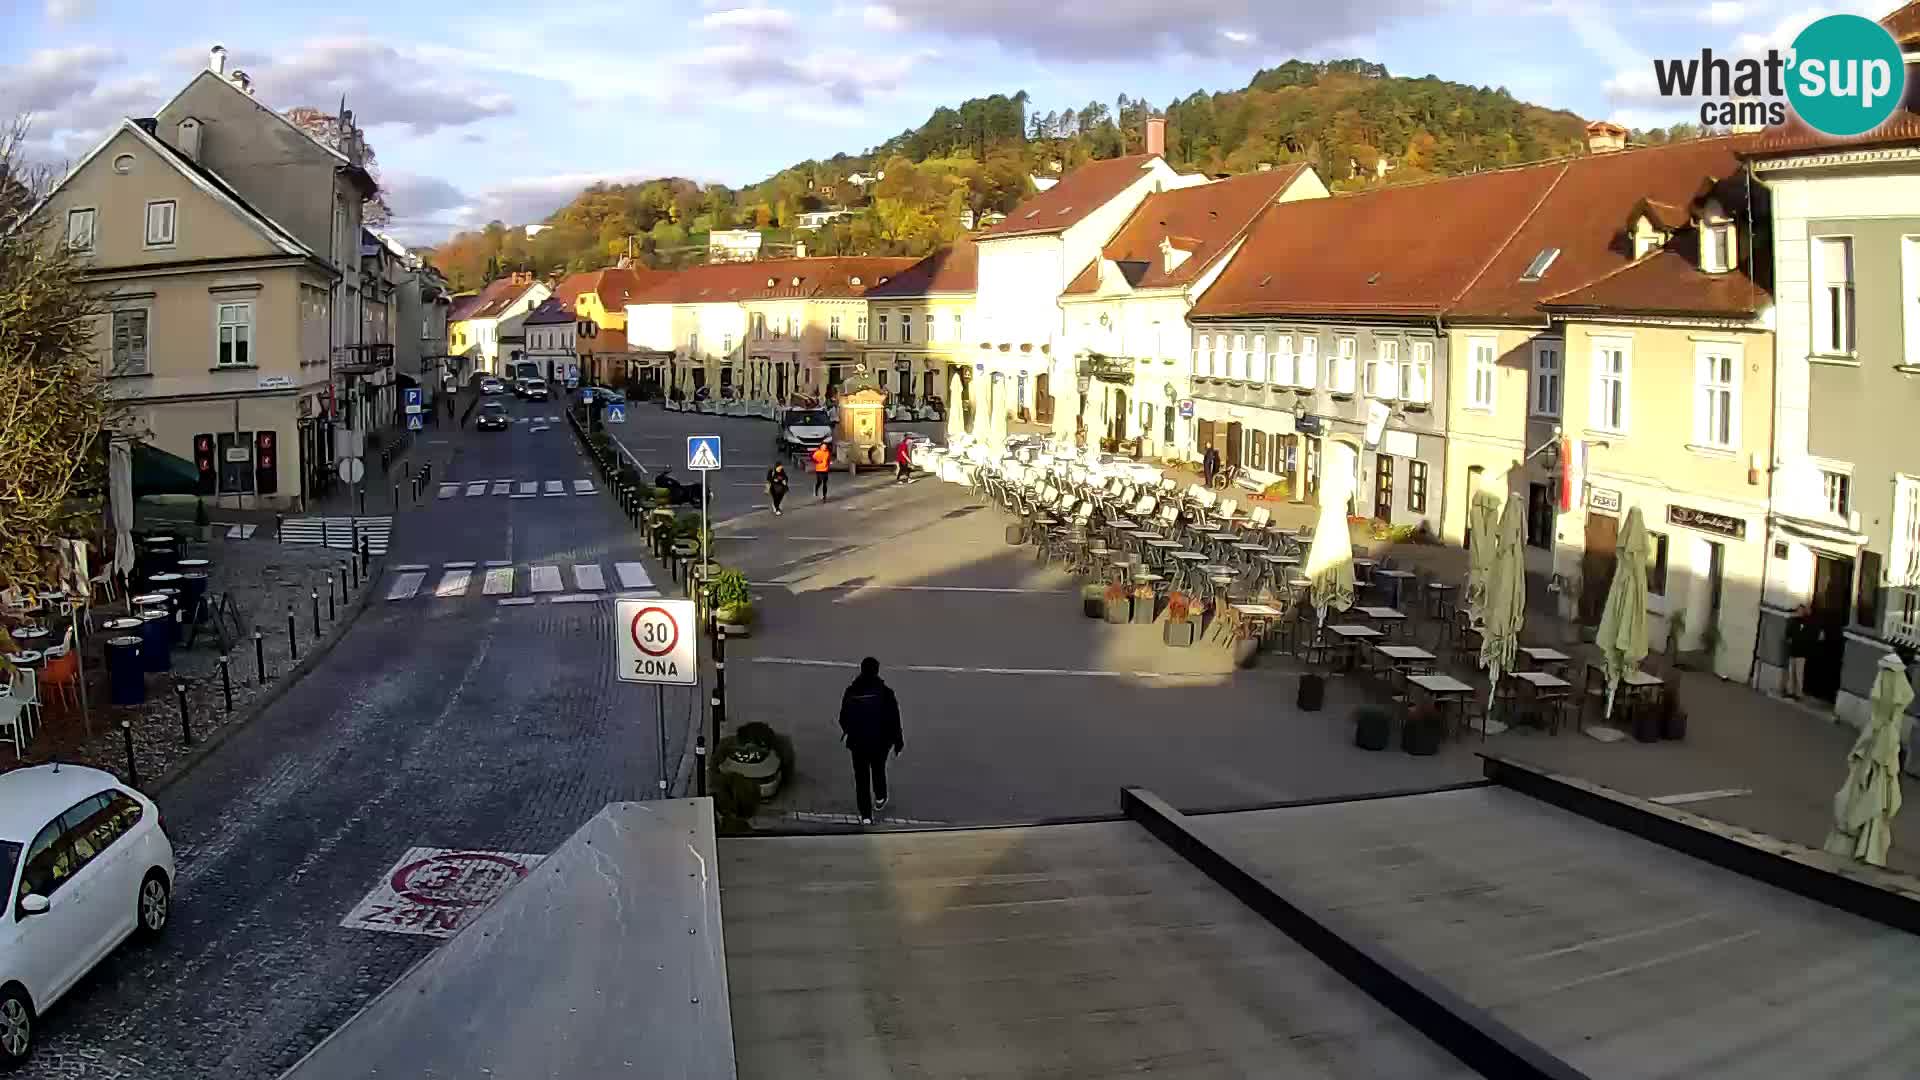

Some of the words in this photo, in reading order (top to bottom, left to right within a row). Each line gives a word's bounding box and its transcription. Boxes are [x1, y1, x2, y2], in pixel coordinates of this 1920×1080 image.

[409, 391, 417, 403] P
[644, 622, 668, 643] 30
[634, 659, 678, 677] ZONA
[360, 904, 464, 931] ZON
